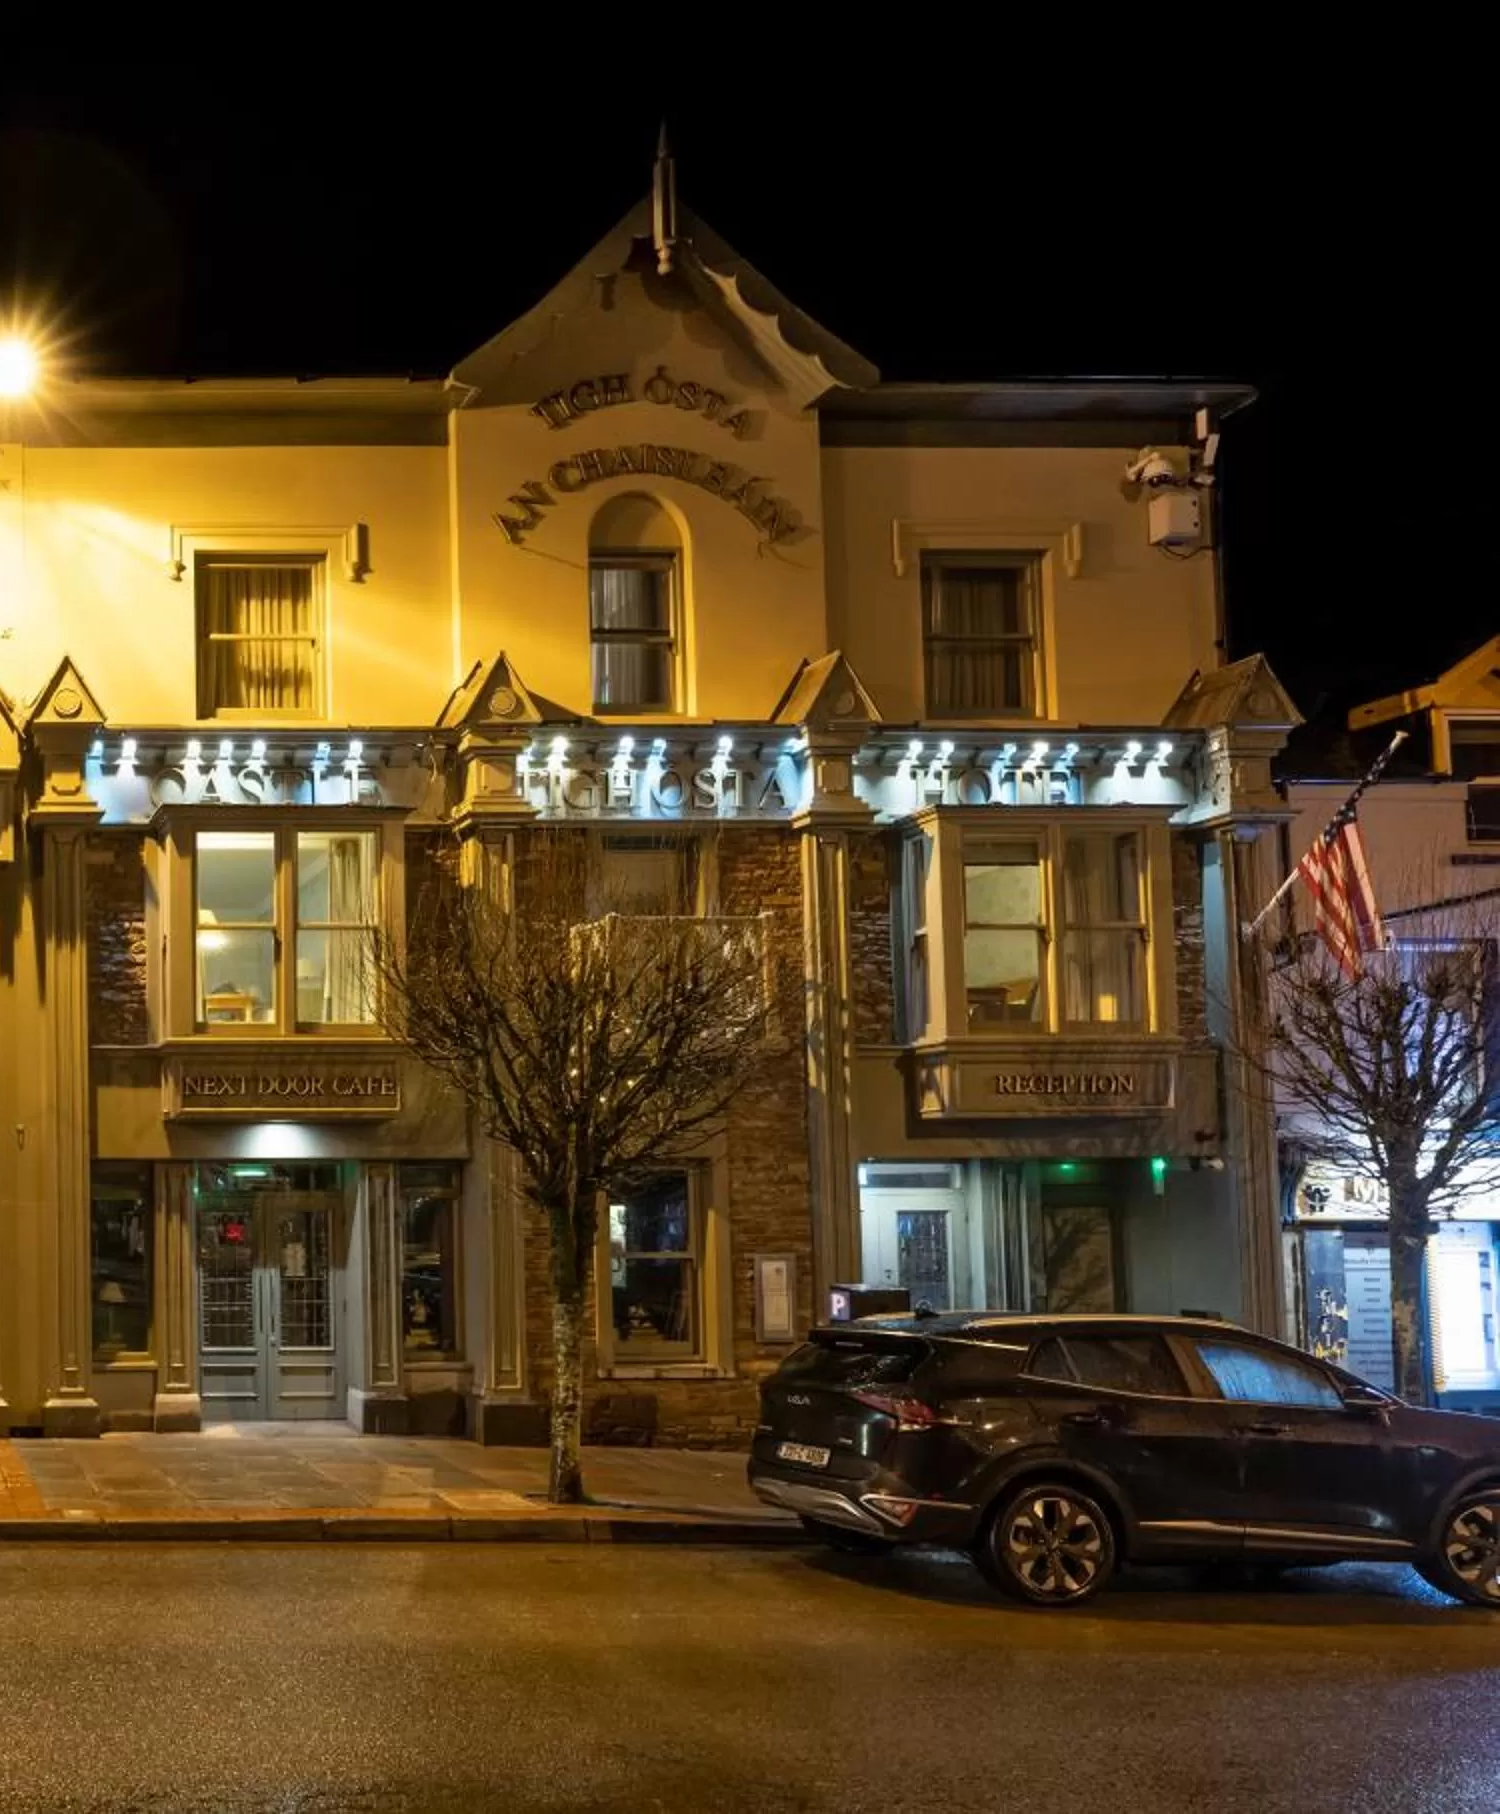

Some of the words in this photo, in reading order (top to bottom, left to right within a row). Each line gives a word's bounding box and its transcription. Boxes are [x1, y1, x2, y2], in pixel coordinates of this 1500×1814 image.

[185, 1076, 246, 1095] NEXT
[258, 1076, 325, 1095] DOOR
[997, 1074, 1134, 1094] RECEPTION
[831, 1294, 845, 1316] P
